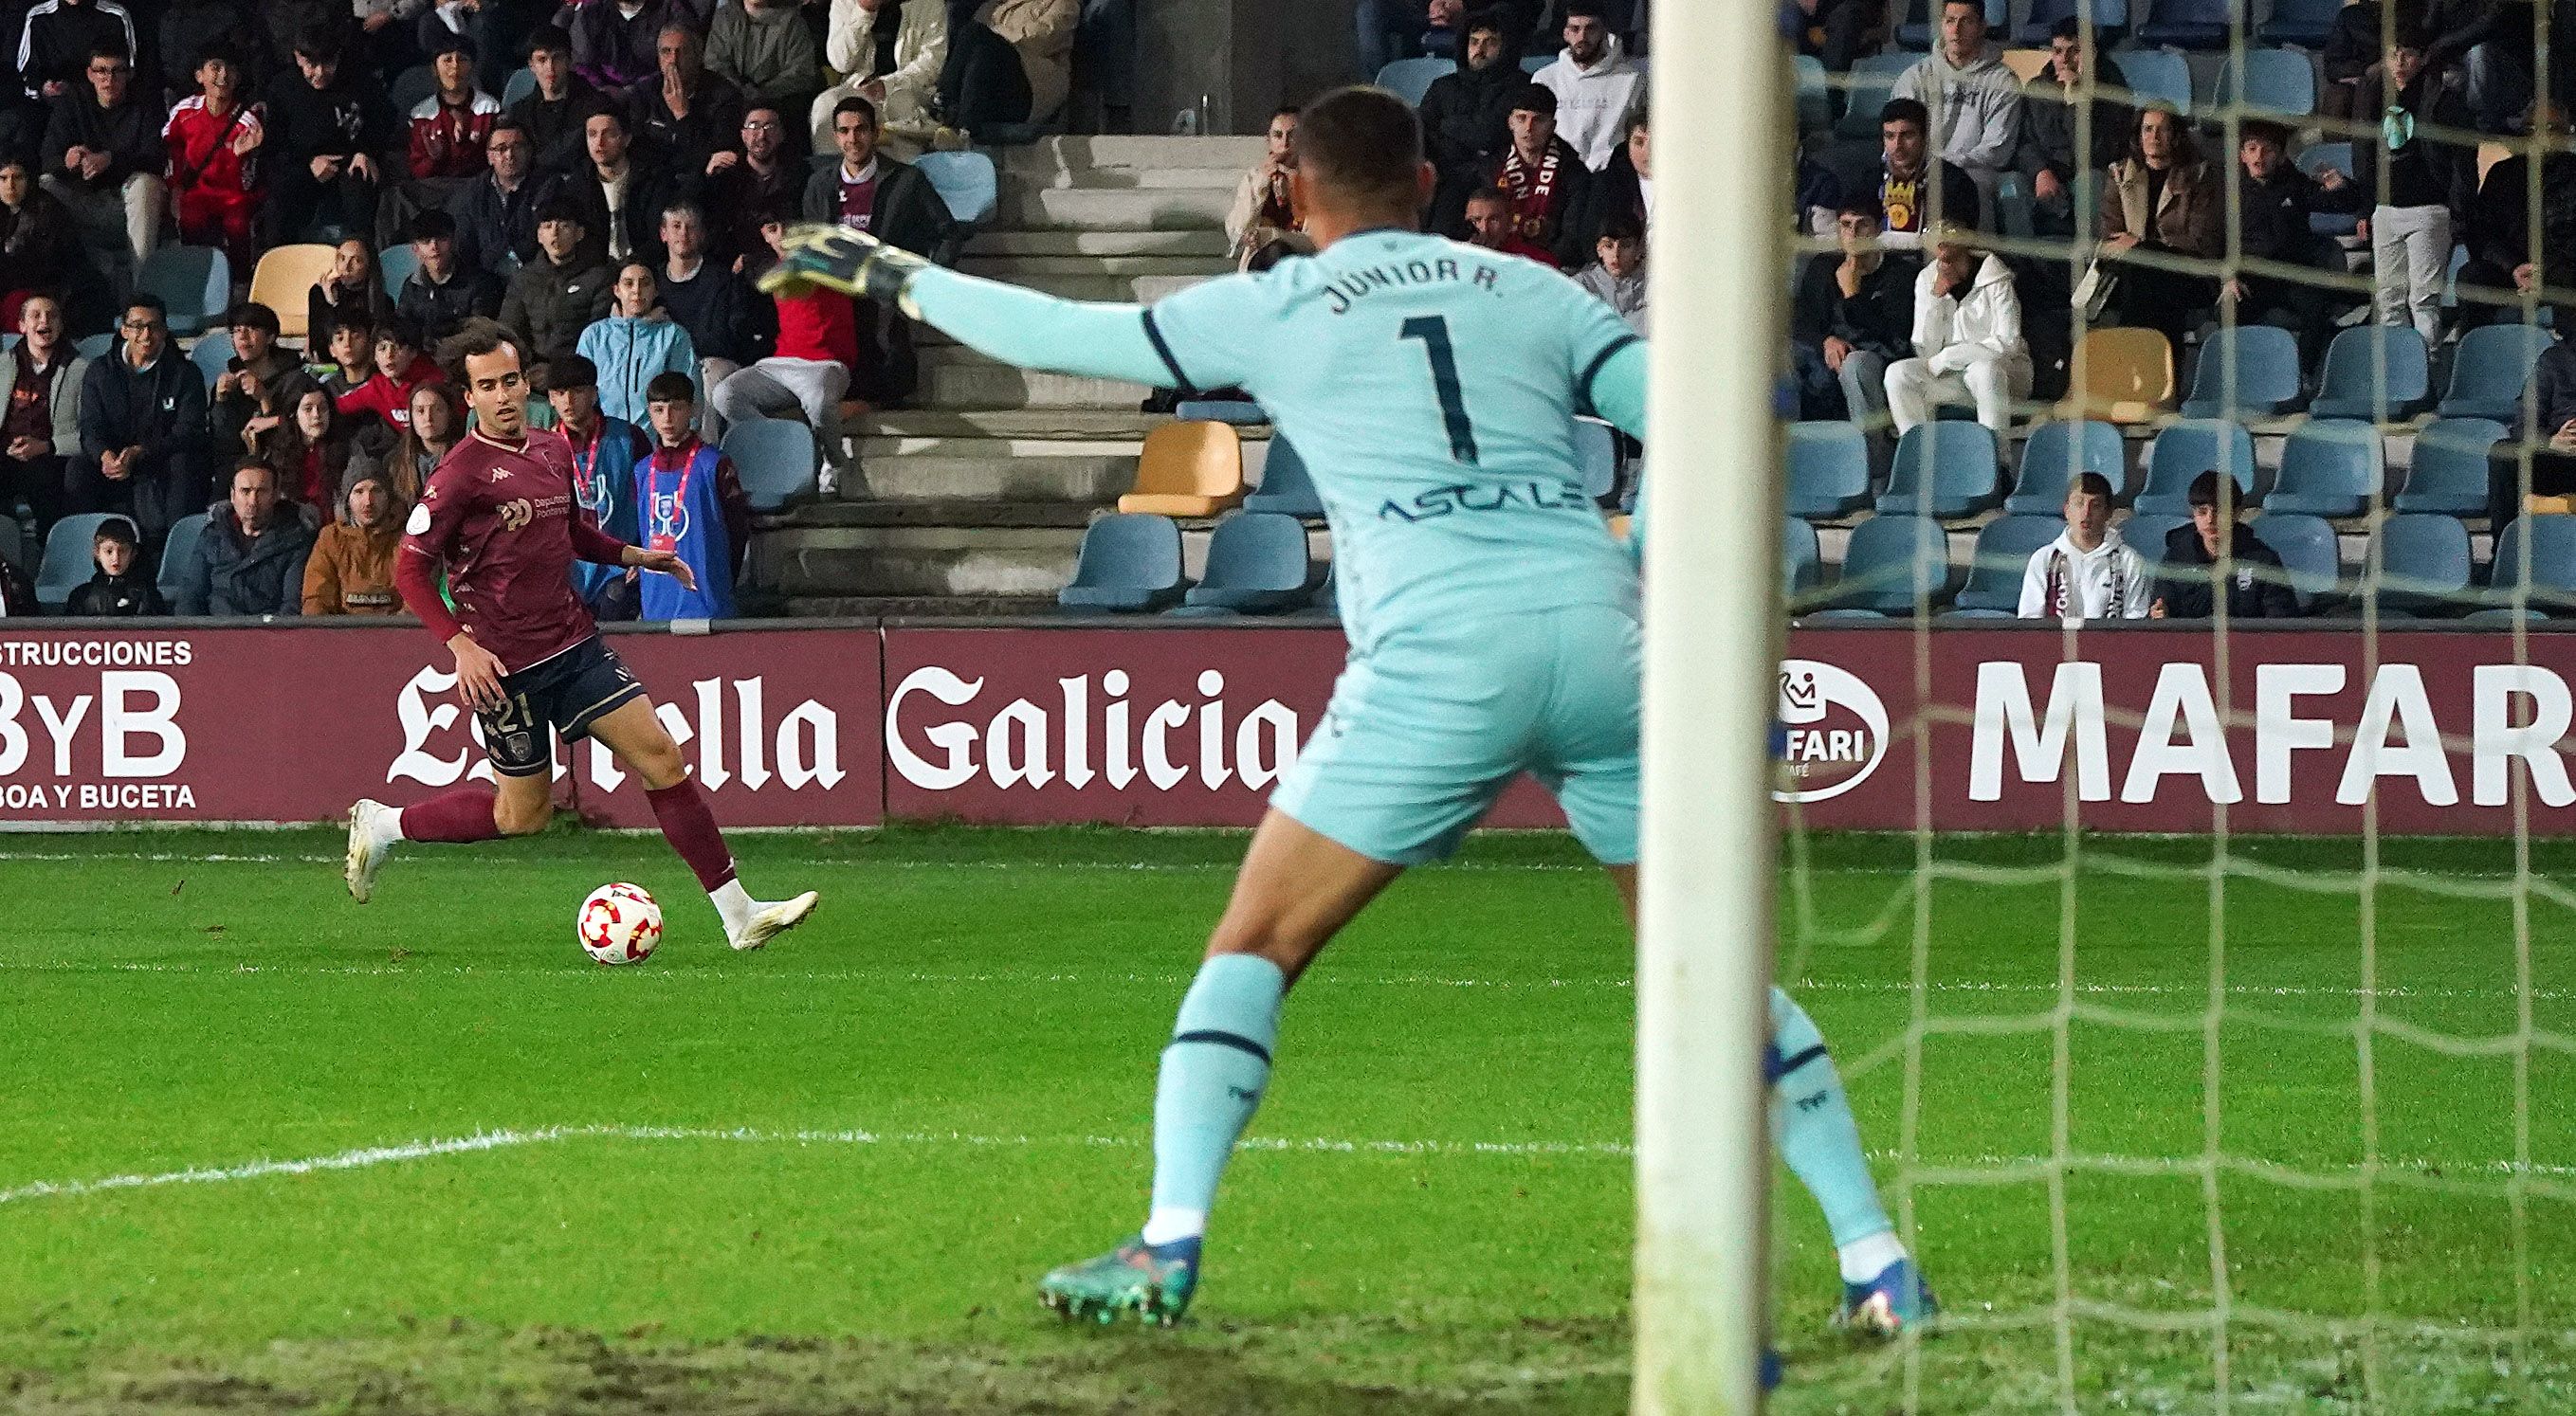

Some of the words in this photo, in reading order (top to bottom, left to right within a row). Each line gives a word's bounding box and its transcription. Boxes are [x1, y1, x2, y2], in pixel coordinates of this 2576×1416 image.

[1474, 264, 1504, 299] R.
[1398, 315, 1478, 466] 1
[0, 641, 192, 665] TRUCCIONES
[494, 691, 534, 734] 21
[886, 665, 1299, 792] Galicia
[1782, 729, 1865, 762] FARI
[1968, 662, 2576, 808] MAFAR
[0, 784, 48, 809] OA
[54, 784, 72, 808] Y
[80, 784, 196, 808] BUCETA
